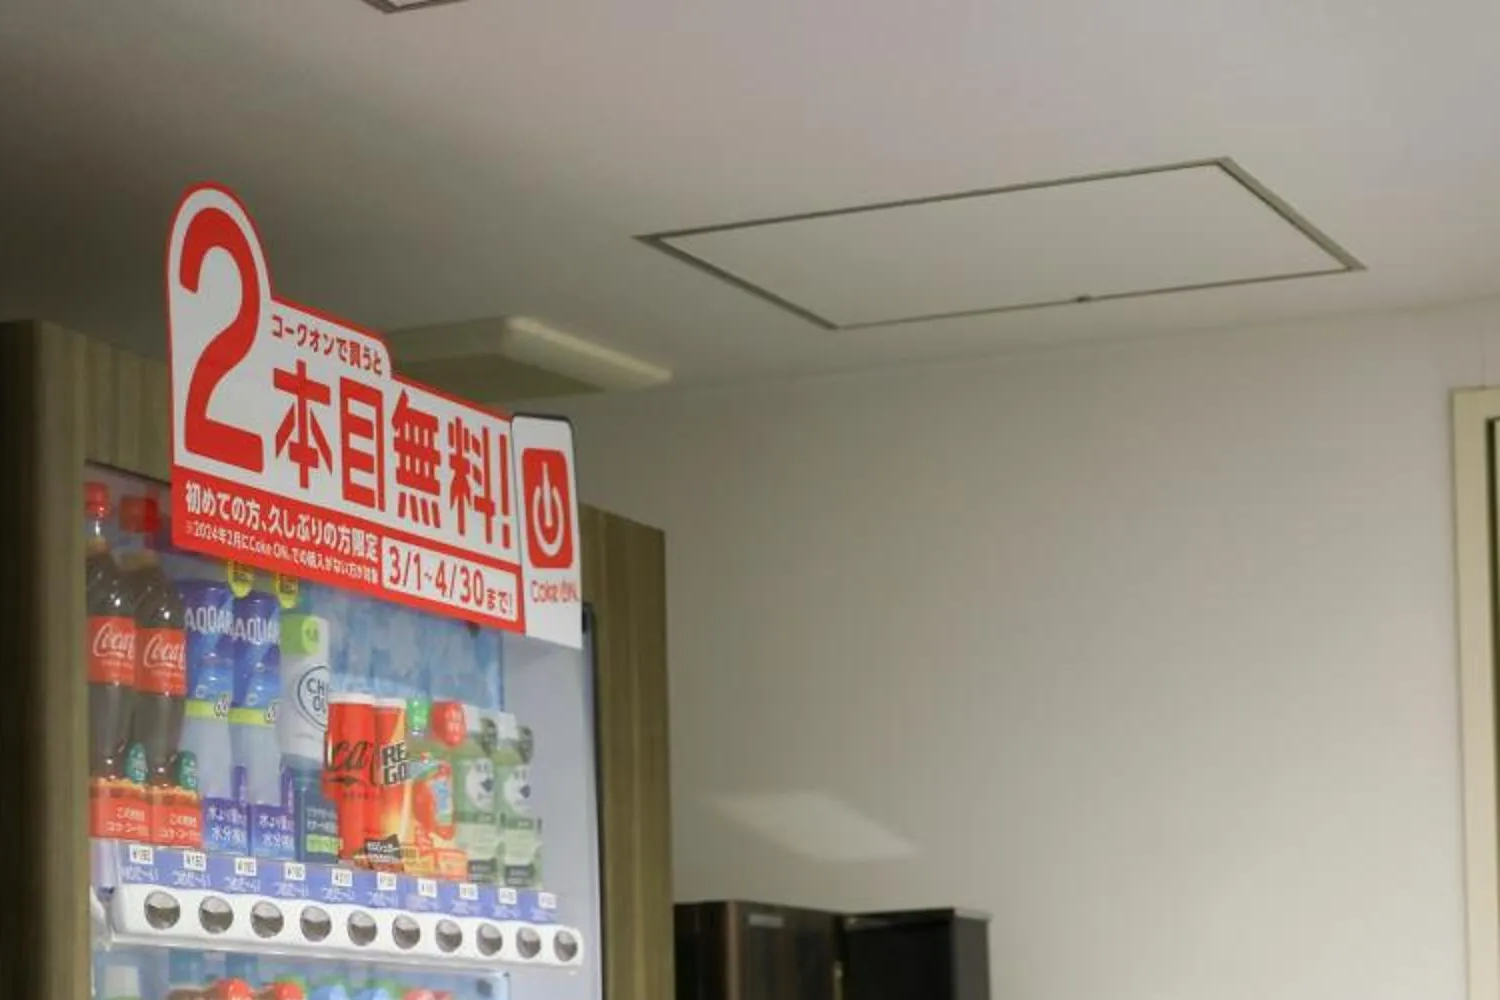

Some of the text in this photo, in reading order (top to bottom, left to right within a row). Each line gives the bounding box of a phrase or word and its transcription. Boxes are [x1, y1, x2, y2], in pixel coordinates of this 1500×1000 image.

[271, 313, 382, 376] コークオンで買うと
[185, 479, 379, 563] 初めての方、久しぶりの方限定
[531, 579, 558, 603] Coke
